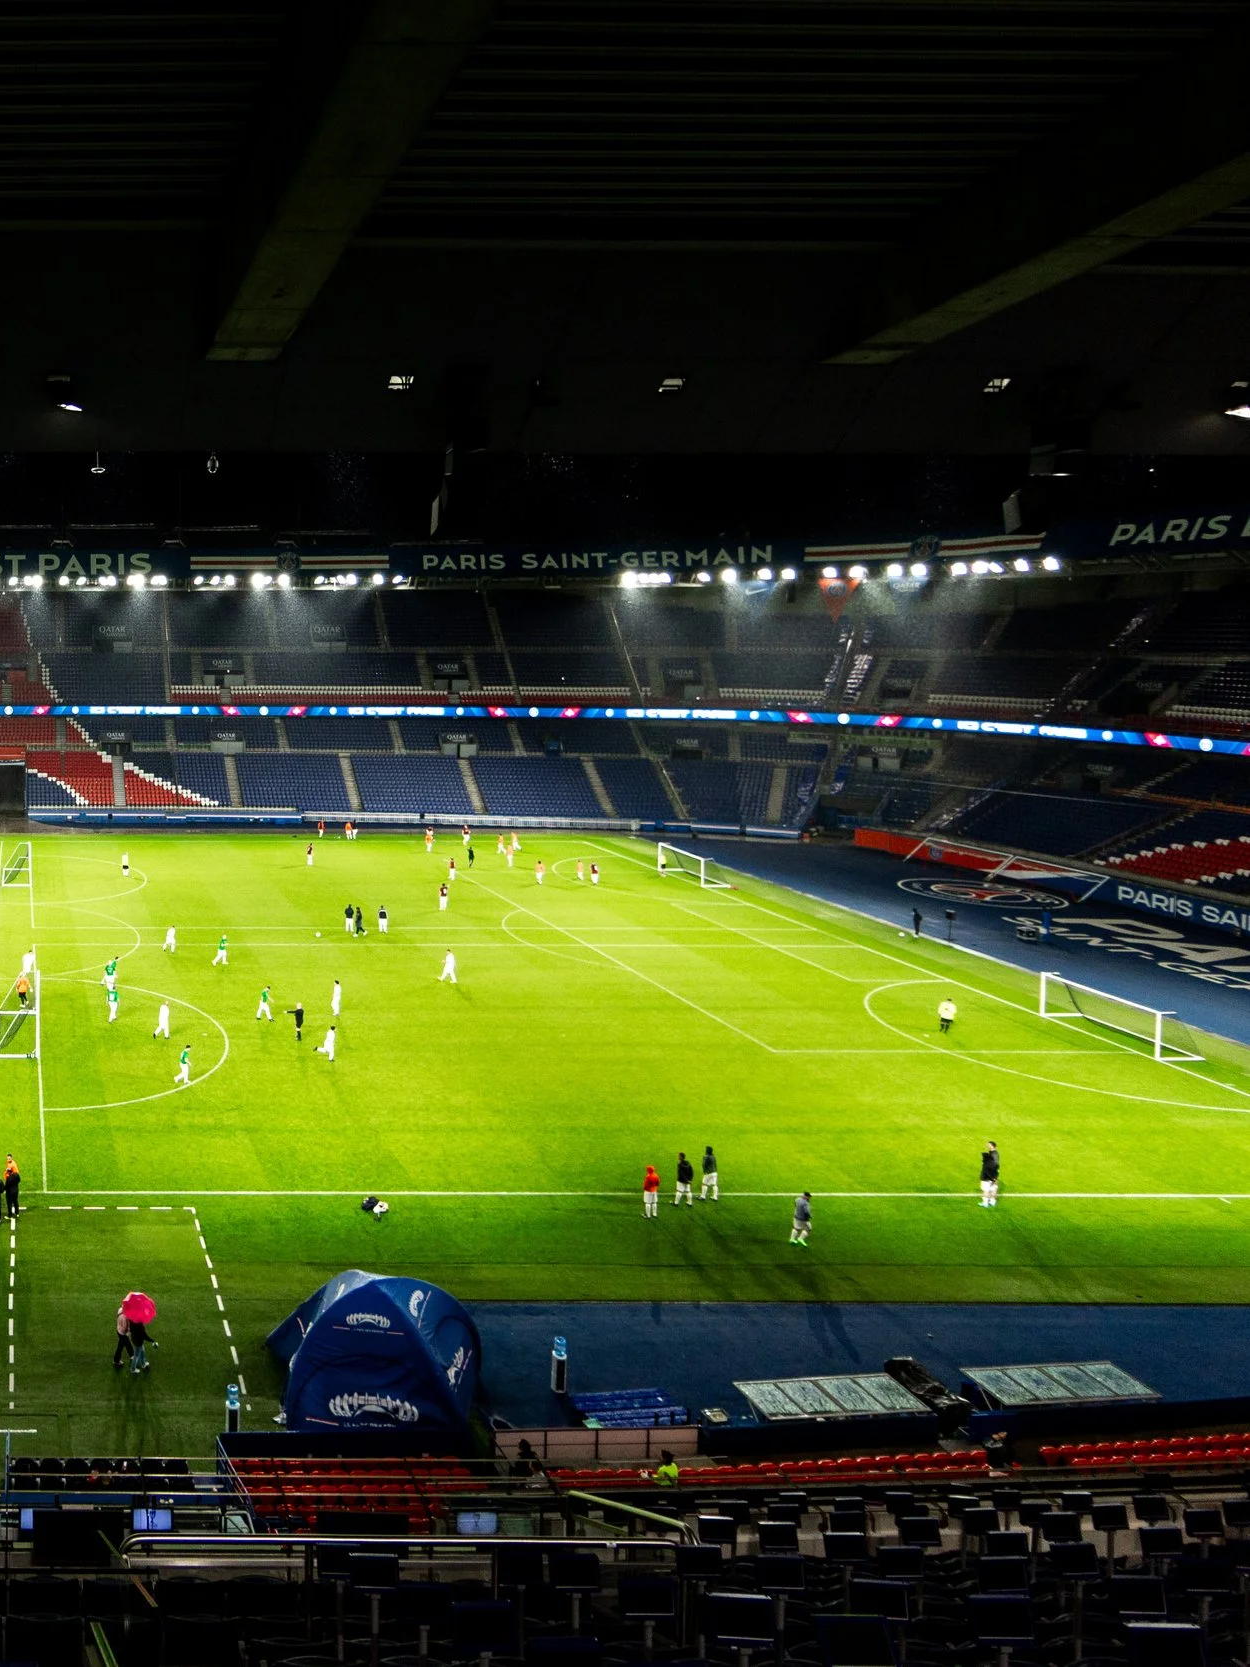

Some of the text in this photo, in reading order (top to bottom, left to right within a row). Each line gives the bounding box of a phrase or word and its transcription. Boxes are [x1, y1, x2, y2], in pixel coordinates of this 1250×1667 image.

[1109, 515, 1232, 546] PARIS
[38, 552, 152, 576] PARIS
[422, 544, 773, 571] PARIS SAINT-GERMAIN
[98, 625, 126, 634] QATAR
[1117, 885, 1250, 932] PARIS SAI
